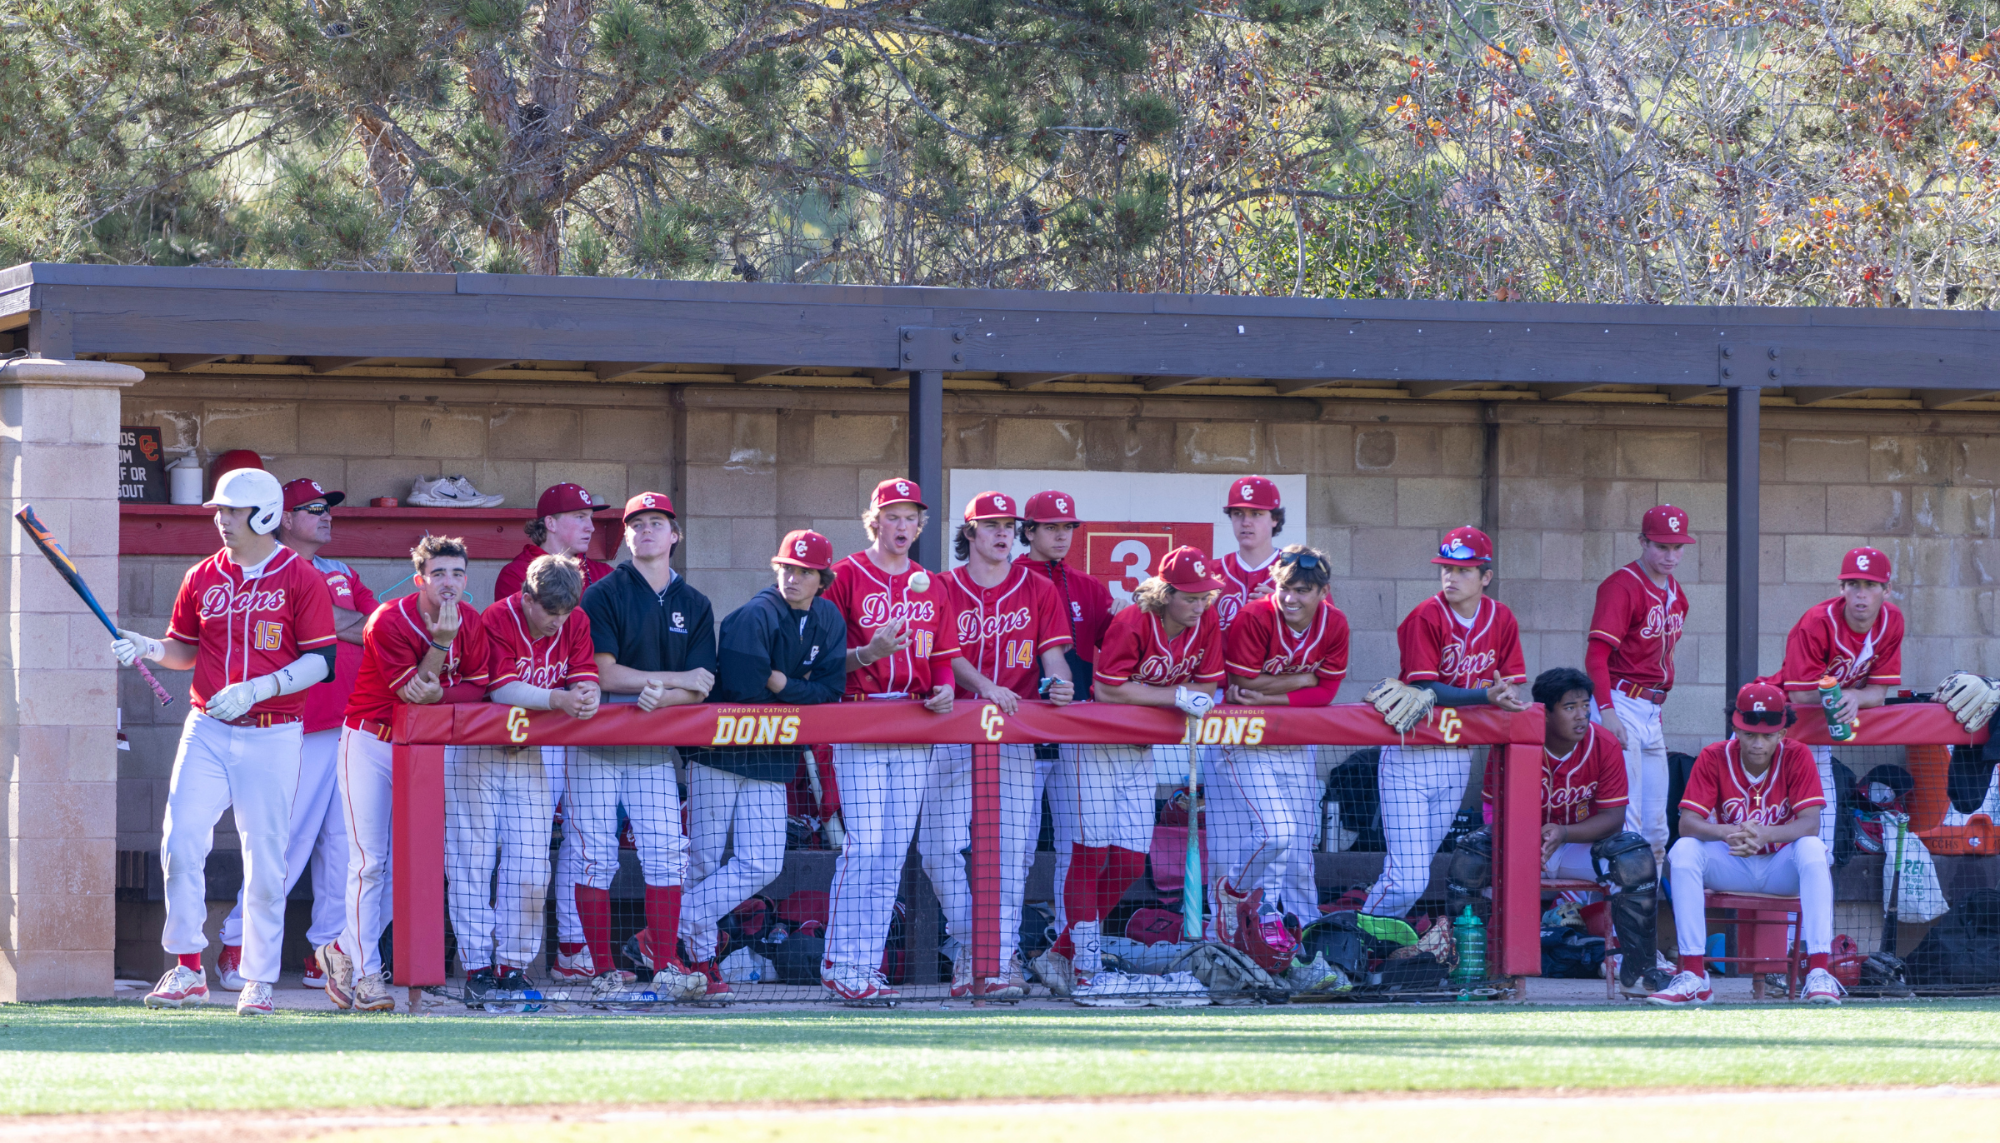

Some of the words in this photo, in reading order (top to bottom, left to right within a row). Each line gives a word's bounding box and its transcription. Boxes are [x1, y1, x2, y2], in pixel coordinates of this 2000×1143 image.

[120, 432, 136, 446] DS
[119, 467, 126, 480] F
[130, 467, 147, 481] OR
[1108, 539, 1151, 604] 3
[201, 582, 285, 620] Dons
[860, 593, 935, 628] Dons
[254, 620, 283, 650] 15
[958, 607, 1031, 645] Dons
[1005, 639, 1034, 669] 14
[1439, 643, 1496, 676] Dons
[711, 715, 801, 745] DONS
[1180, 716, 1267, 745] DONS
[1720, 797, 1791, 827] Dons
[1931, 840, 1959, 850] CCHS
